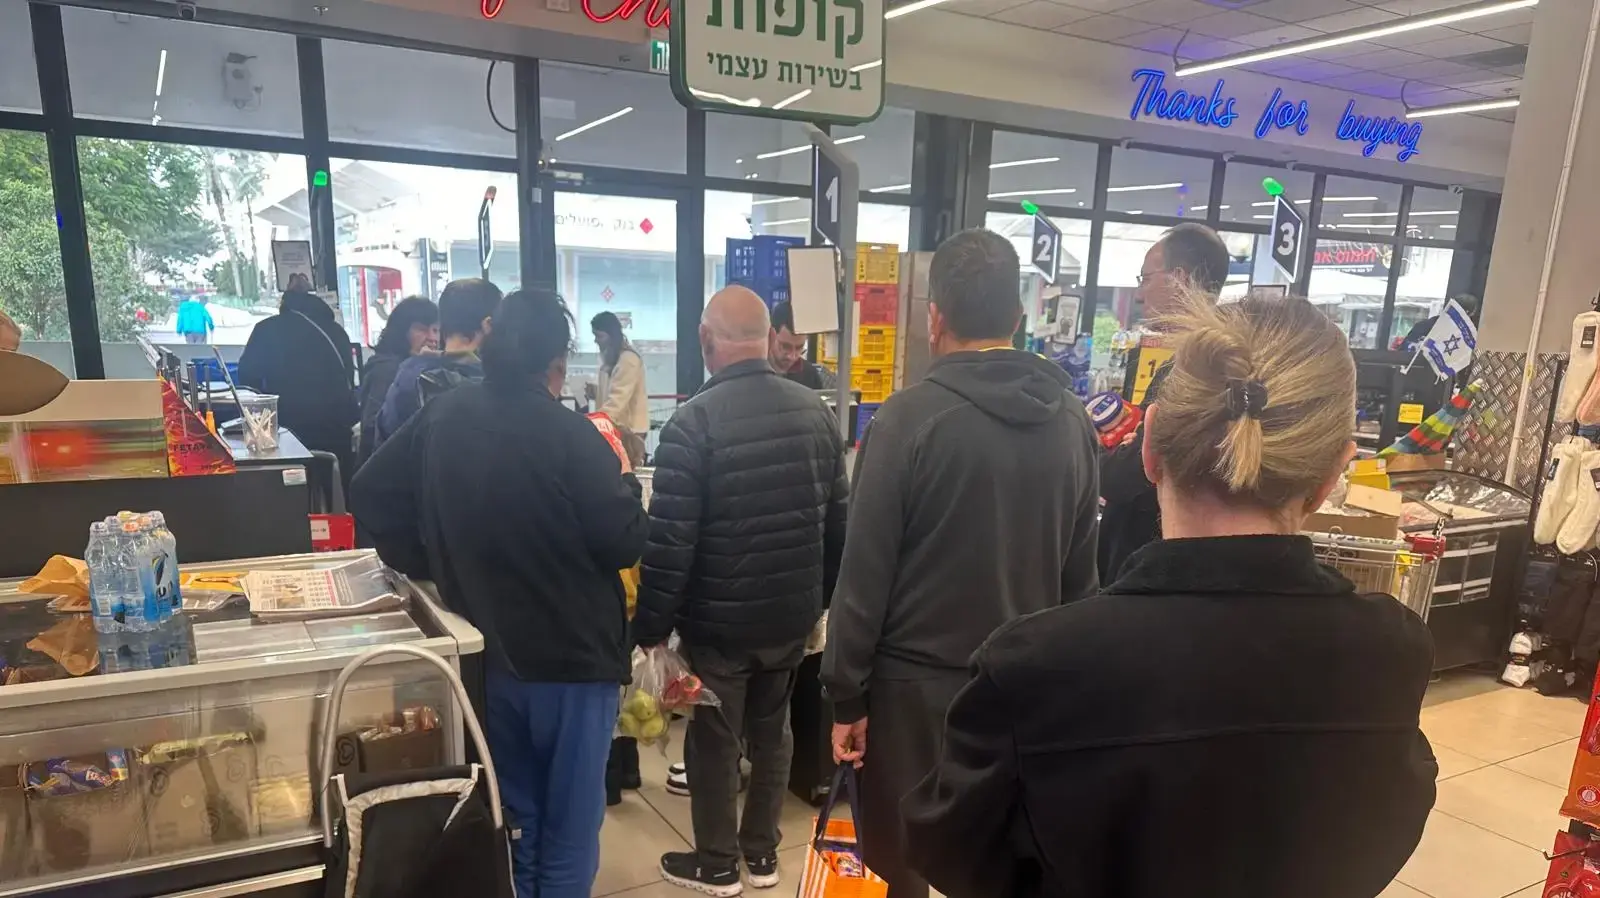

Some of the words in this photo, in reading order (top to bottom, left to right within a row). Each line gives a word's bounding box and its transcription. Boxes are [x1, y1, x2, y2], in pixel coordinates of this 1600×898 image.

[706, 0, 864, 59] קופות
[706, 52, 768, 80] עצמי
[777, 60, 862, 90] בשירות
[1131, 68, 1239, 128] Thanks
[1255, 87, 1308, 139] for
[1336, 100, 1423, 162] buying
[825, 176, 838, 222] 1
[1037, 234, 1051, 262] 2
[1277, 222, 1296, 256] 3
